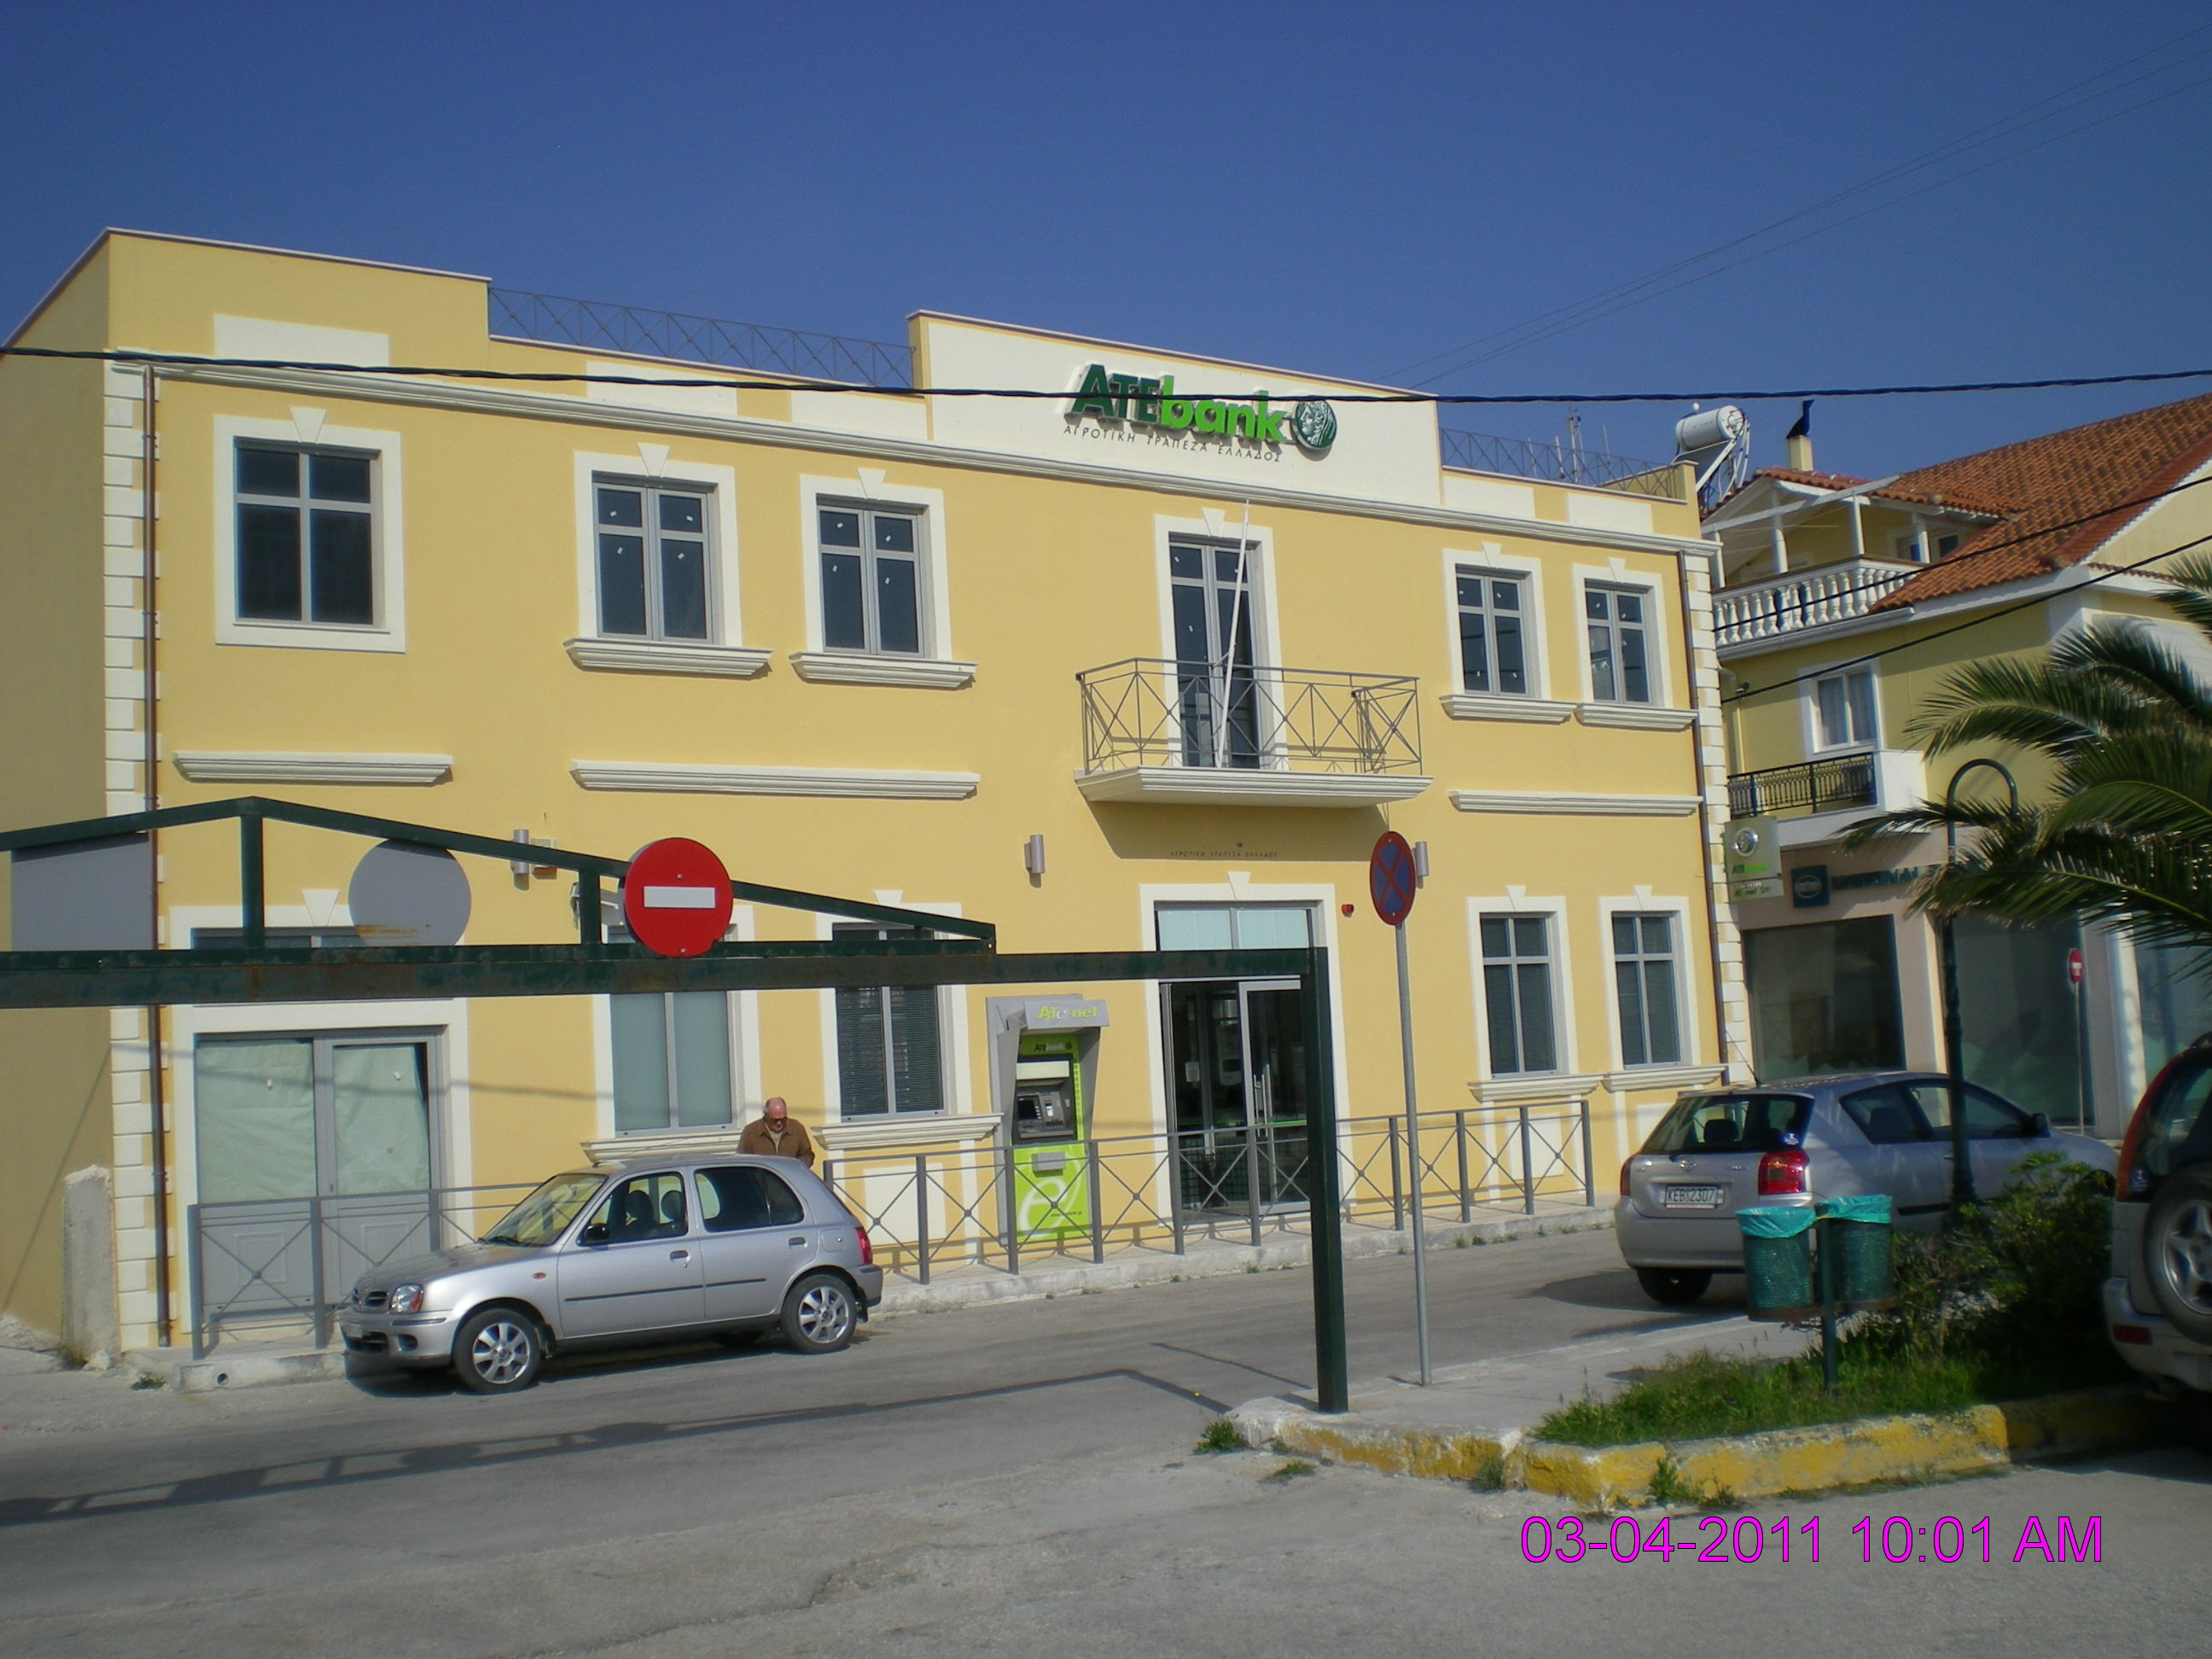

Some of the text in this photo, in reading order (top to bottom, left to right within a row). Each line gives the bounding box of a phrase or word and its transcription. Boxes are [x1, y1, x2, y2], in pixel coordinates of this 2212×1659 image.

[1067, 364, 1286, 443] ATEbank
[1063, 425, 1281, 463] ΑΓΡΟΤΙΚΗ ΤΡΑΠΕΖΑ ΕΛΛΑΔΟΣ
